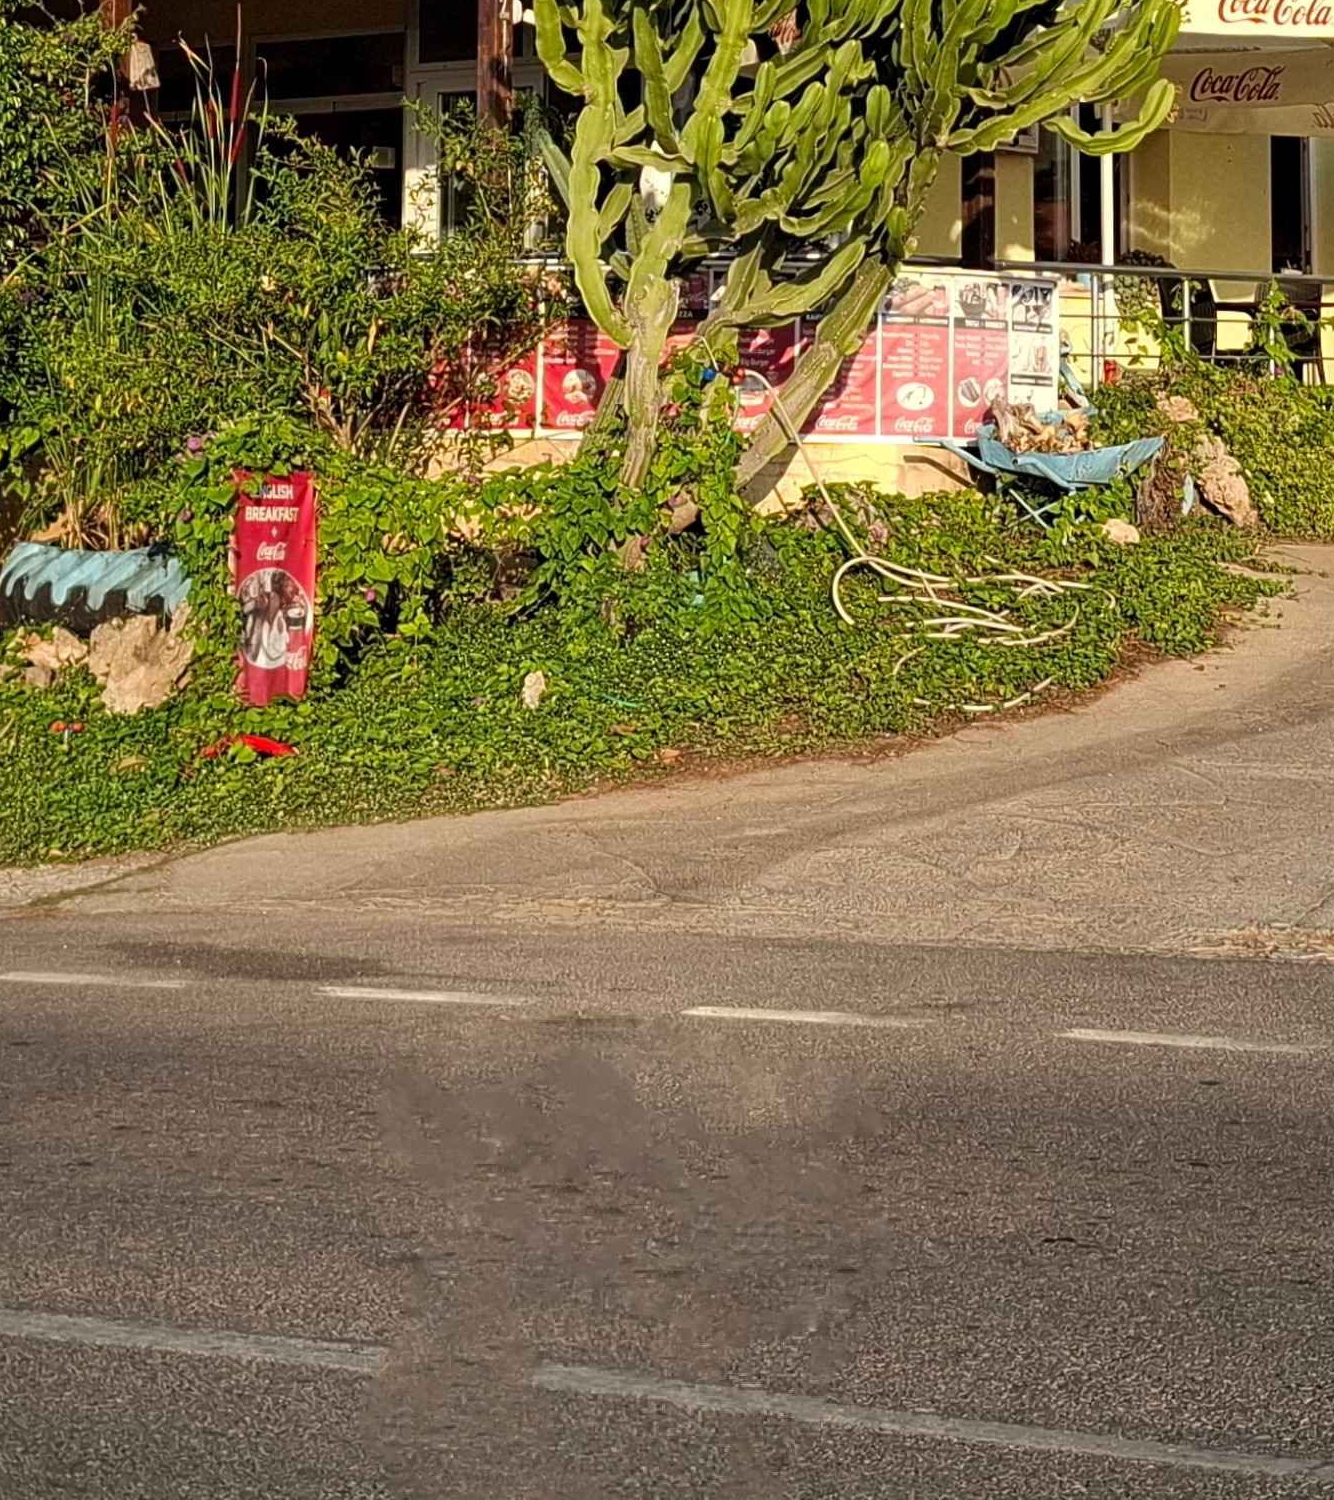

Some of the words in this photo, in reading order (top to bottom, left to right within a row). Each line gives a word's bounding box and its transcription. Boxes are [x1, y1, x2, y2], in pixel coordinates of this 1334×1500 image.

[1190, 66, 1287, 102] Coca-Cola
[816, 415, 859, 430] Coca-Cola
[895, 416, 935, 434] Coca-Cola
[245, 506, 299, 522] BREAKFAST
